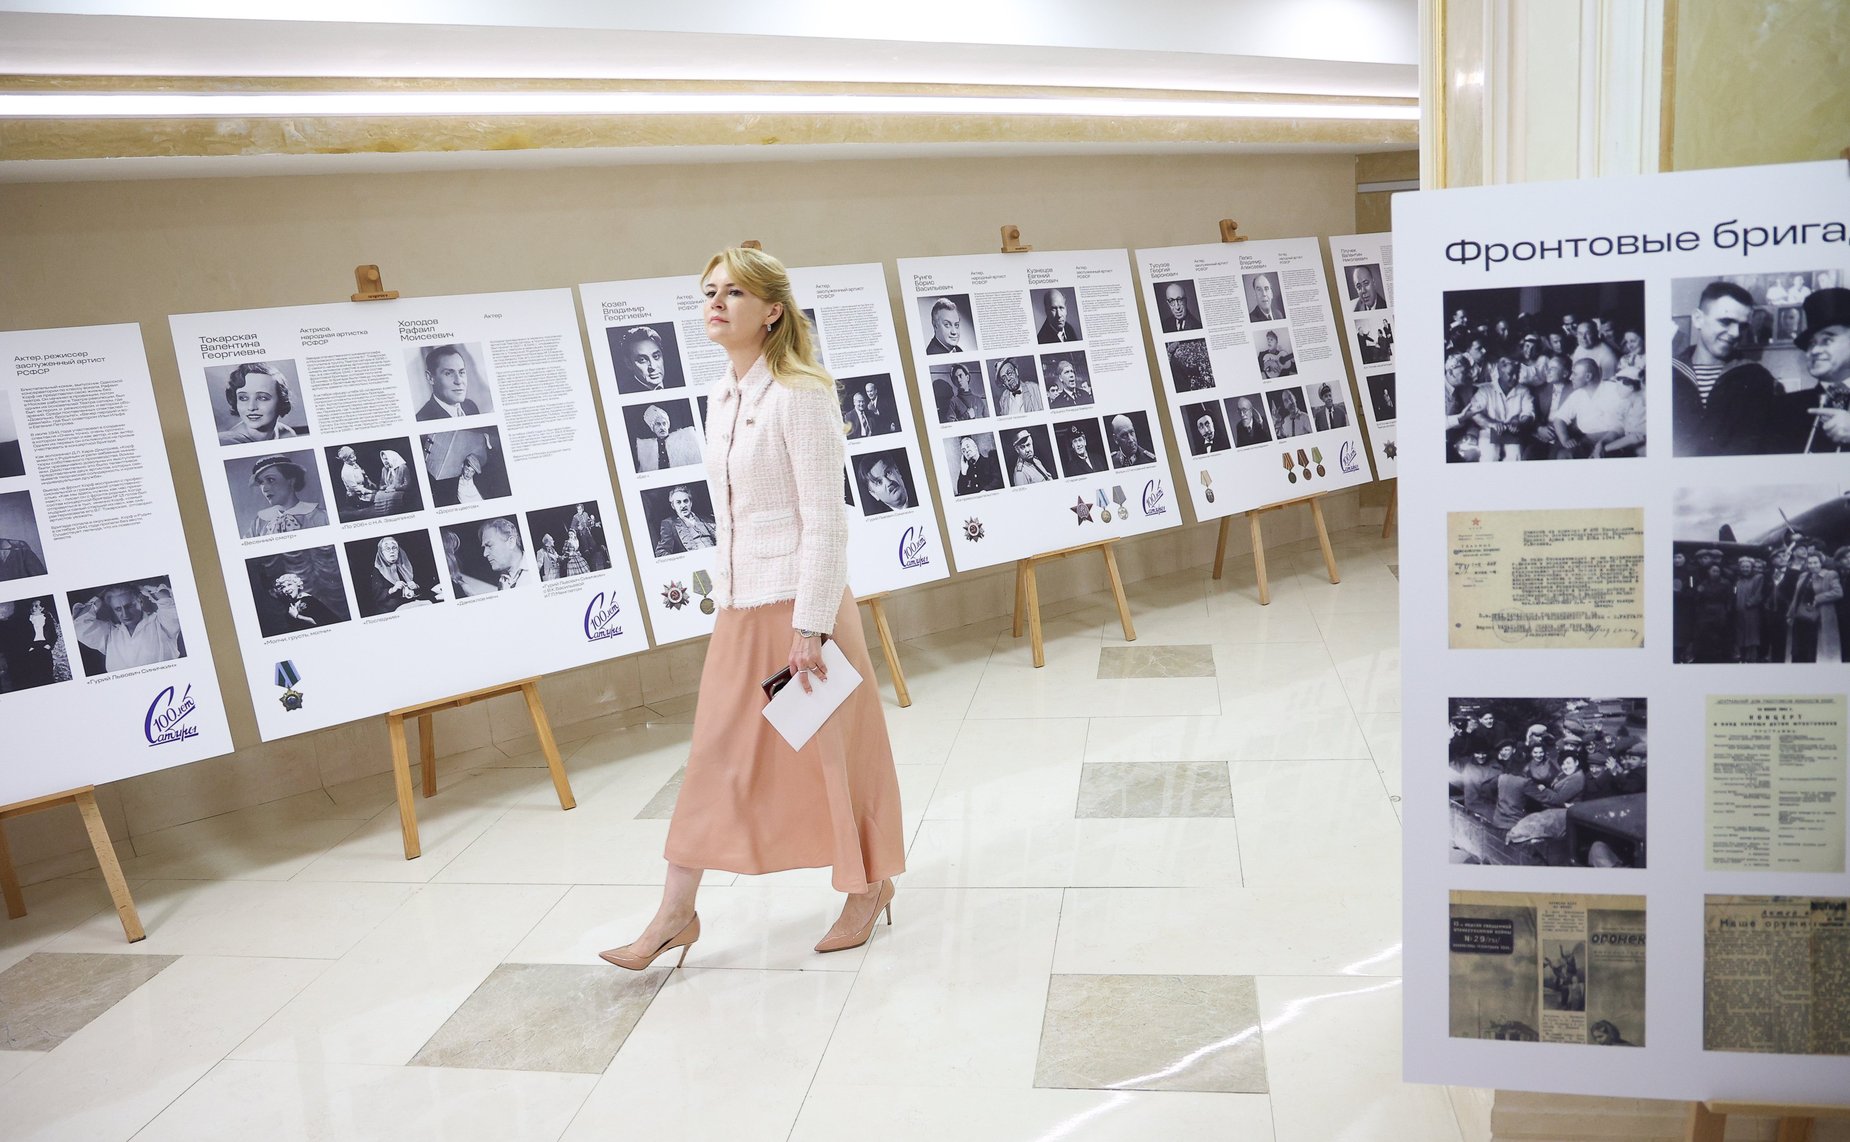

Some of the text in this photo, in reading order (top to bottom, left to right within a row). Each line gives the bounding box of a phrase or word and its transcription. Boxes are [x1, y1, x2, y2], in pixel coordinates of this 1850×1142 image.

[1445, 219, 1850, 271] Фронтовые брига
[913, 274, 933, 282] Рунге
[915, 279, 935, 287] Борис
[603, 306, 645, 315] Владимир
[604, 313, 652, 322] Георгиевич
[398, 319, 439, 328] Холодов
[336, 330, 368, 338] артистка
[399, 326, 435, 335] Рафаил
[198, 333, 258, 344] Токарская
[400, 332, 454, 342] Моисеевич
[200, 341, 260, 352] Валентина
[44, 351, 88, 360] режиссер
[202, 348, 266, 360] Георгиевна
[15, 357, 106, 369] заслуженный артист
[16, 368, 50, 376] РСФСР
[904, 543, 917, 558] 100
[591, 610, 608, 630] 100
[153, 706, 176, 732] 100
